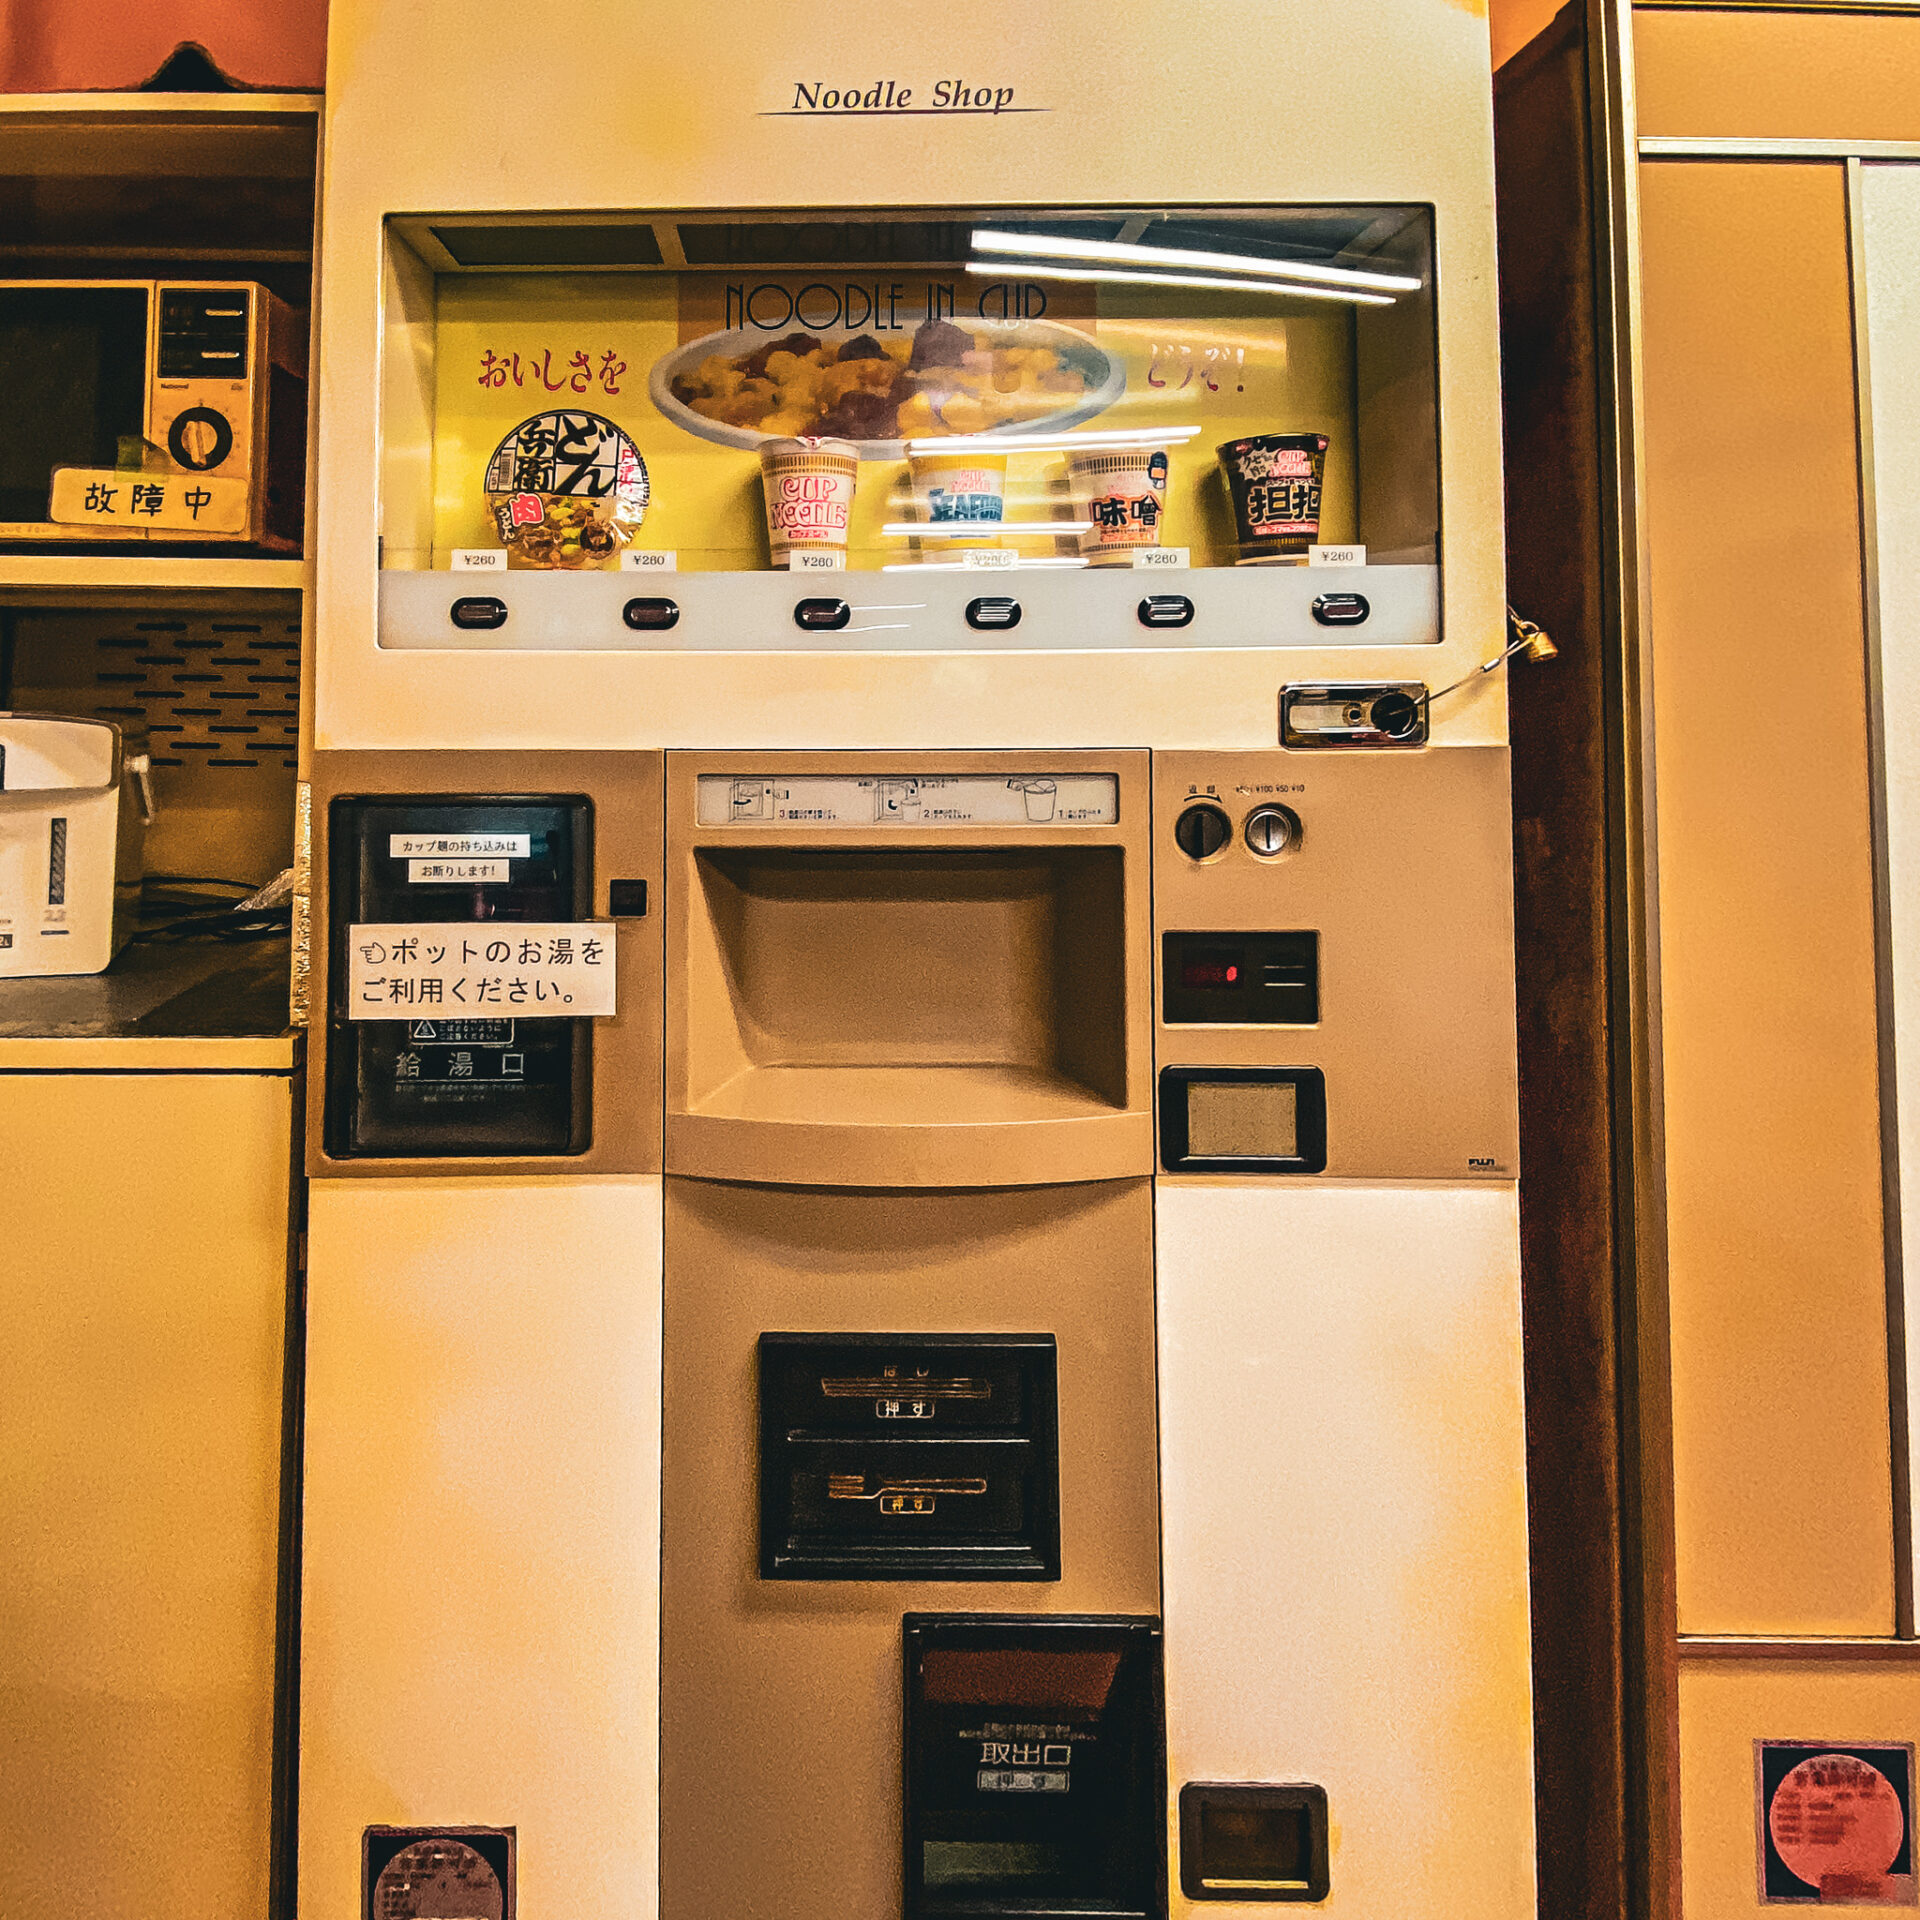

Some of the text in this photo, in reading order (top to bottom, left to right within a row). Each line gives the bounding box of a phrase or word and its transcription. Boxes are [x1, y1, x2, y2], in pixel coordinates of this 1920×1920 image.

[792, 79, 1014, 115] Noodle Shop
[725, 283, 1048, 331] NOODLE IN CUP
[478, 349, 627, 395] おいしさを
[84, 482, 212, 520] 故障中
[780, 476, 838, 501] CUP
[464, 555, 496, 565] ¥260
[633, 555, 665, 565] ¥260
[802, 556, 833, 567] ¥260
[1145, 554, 1177, 564] ¥260
[1322, 551, 1354, 562] ¥260
[391, 936, 604, 965] ポットのお湯を
[362, 976, 576, 1005] ご利用ください。
[396, 1051, 524, 1077] 給湯口
[980, 1742, 1072, 1765] 取出口
